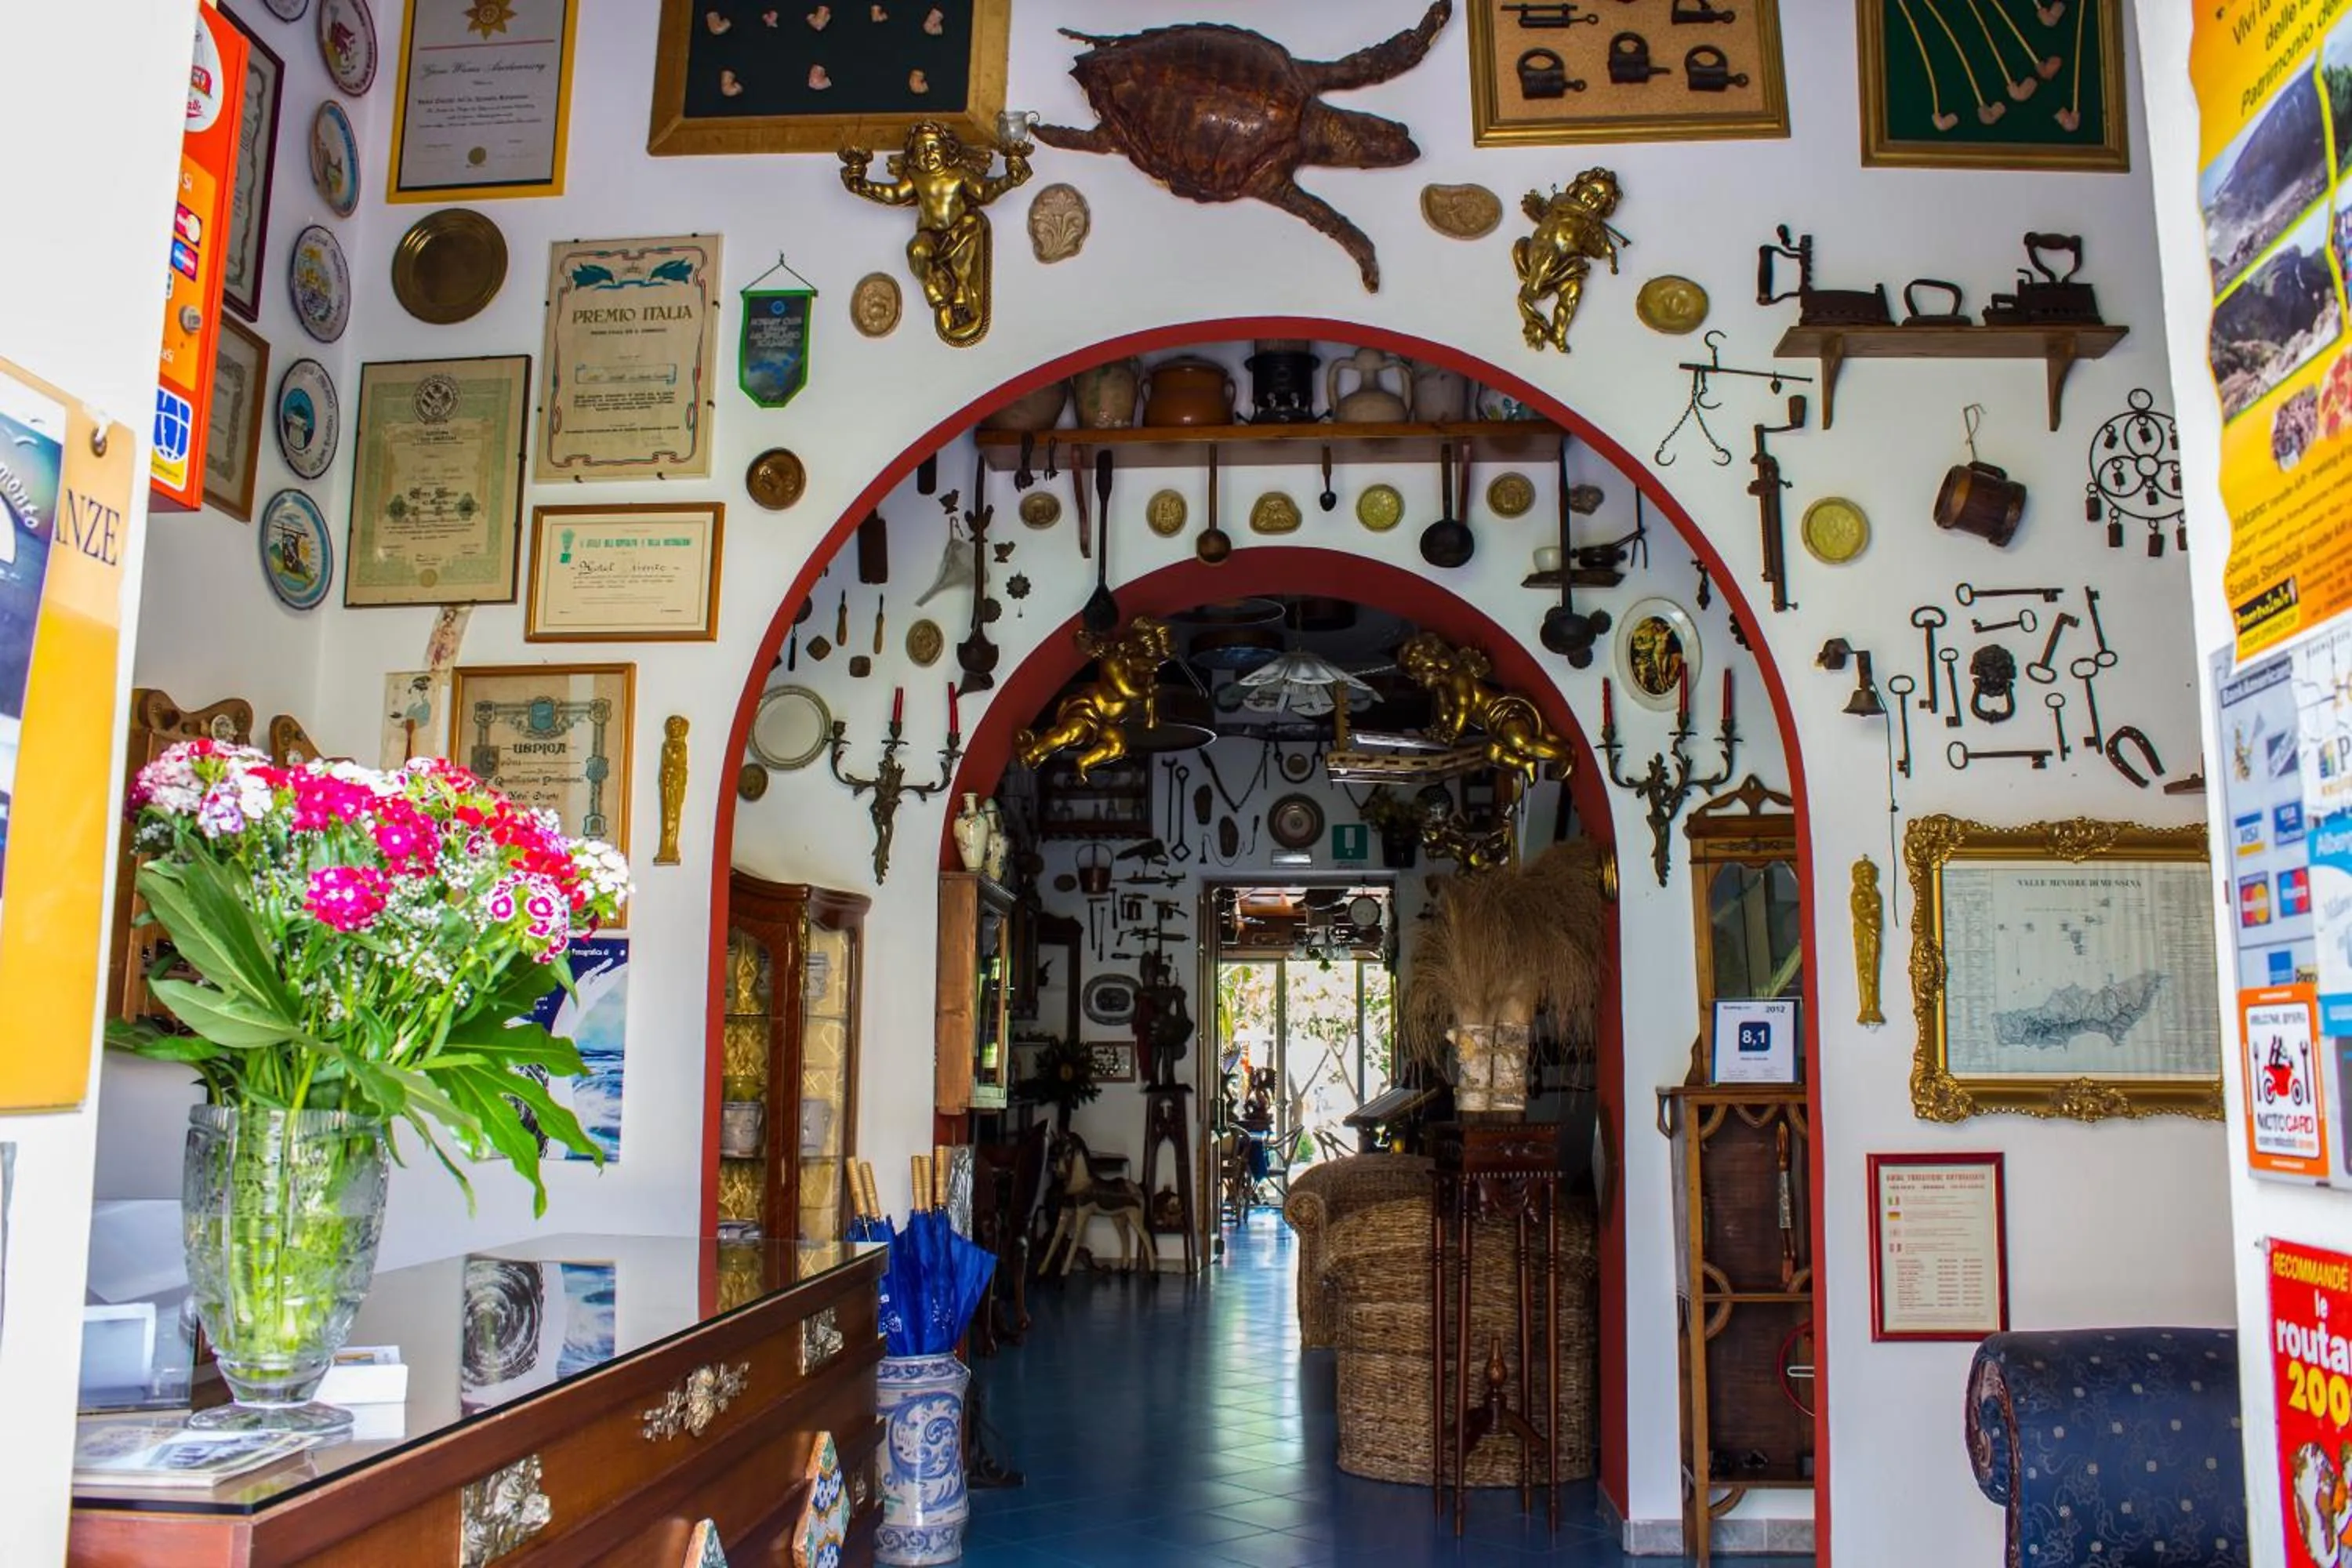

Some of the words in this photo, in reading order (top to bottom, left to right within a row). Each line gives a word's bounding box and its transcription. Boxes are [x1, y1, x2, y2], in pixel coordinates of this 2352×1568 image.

[2241, 22, 2314, 117] Patrimonio
[572, 307, 636, 325] PREMIO
[643, 304, 693, 321] ITALIA
[56, 488, 120, 566] NZE
[1741, 1029, 1766, 1046] 8,1
[2274, 1250, 2350, 1293] RECOMMANDÉ
[2314, 1289, 2328, 1319] le
[2276, 1317, 2352, 1376] routa
[2288, 1359, 2352, 1428] 200
